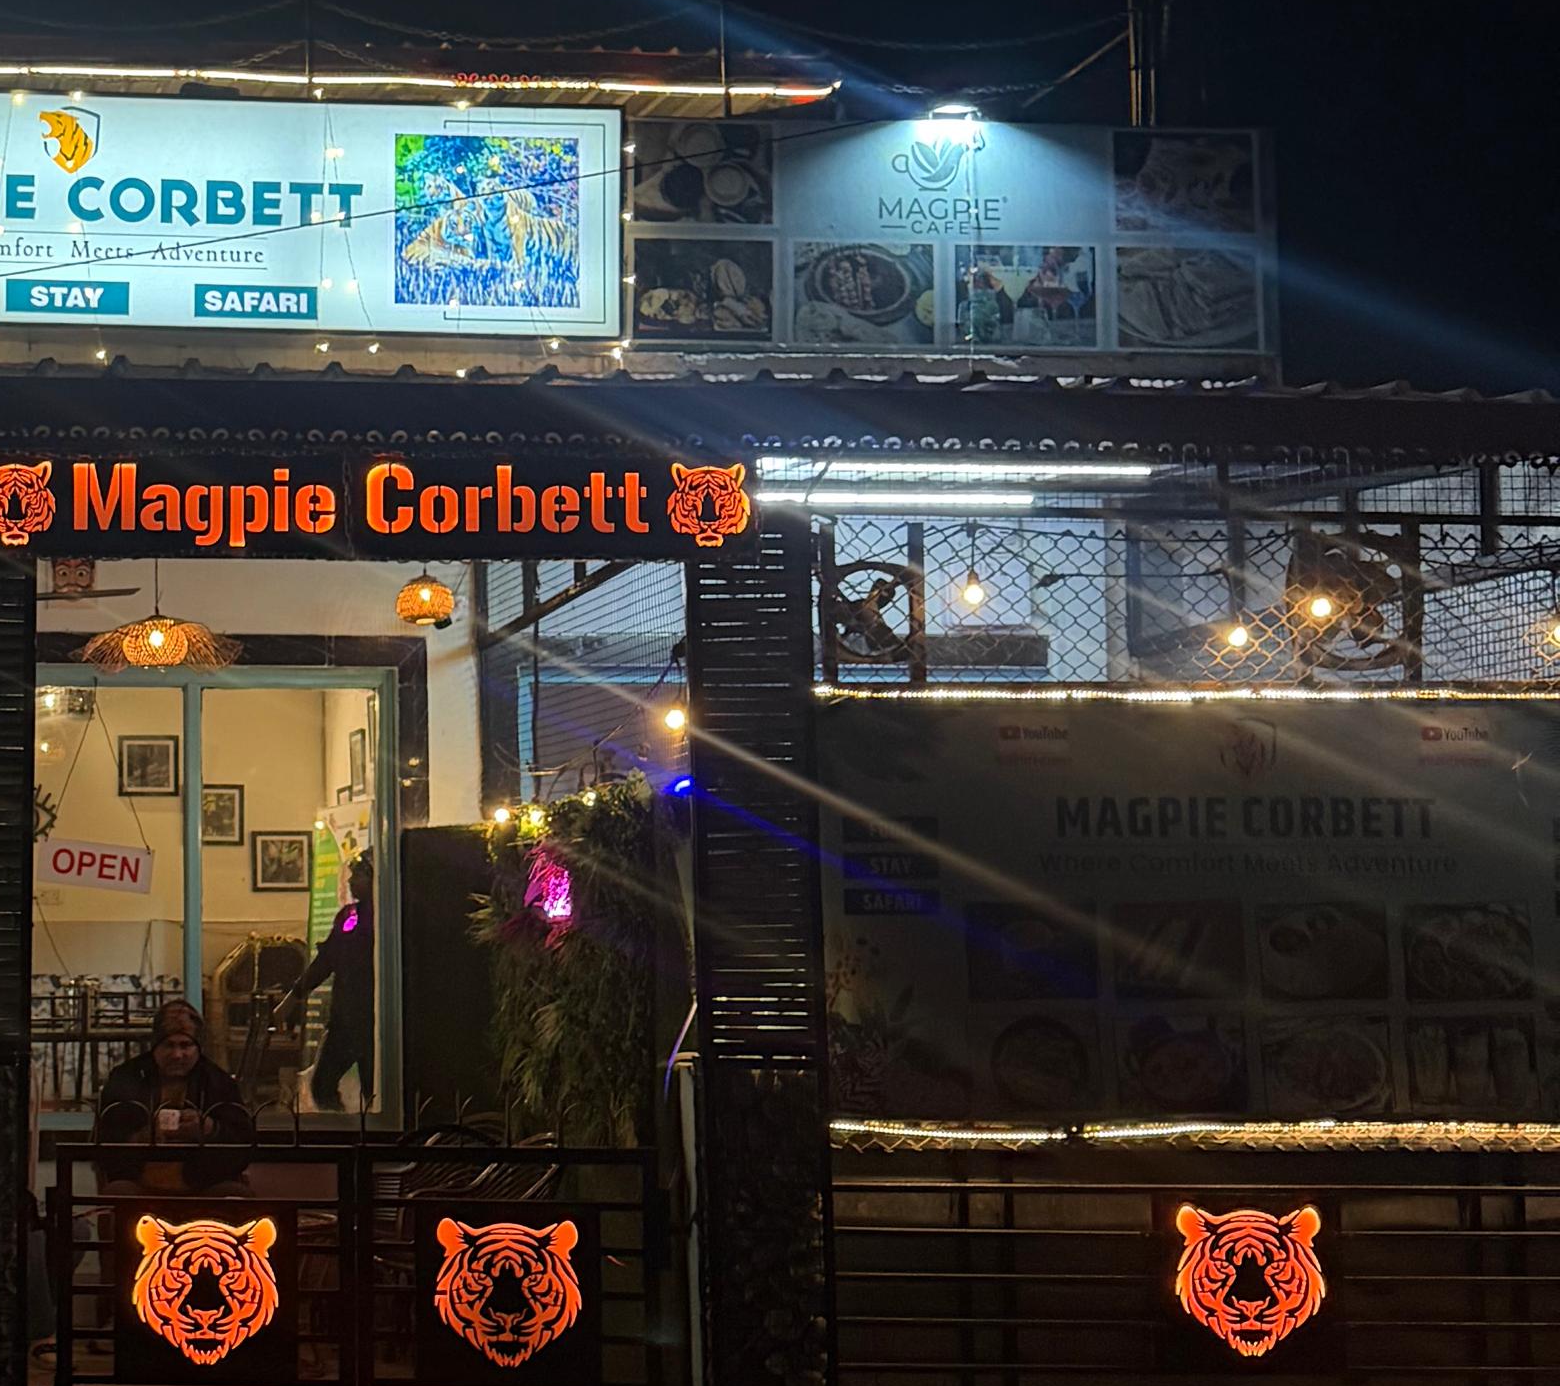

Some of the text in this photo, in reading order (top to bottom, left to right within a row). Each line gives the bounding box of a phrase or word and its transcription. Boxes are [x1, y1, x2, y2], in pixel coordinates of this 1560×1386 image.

[67, 176, 364, 228] CORBETT
[878, 196, 1001, 221] MAGPIE
[911, 220, 969, 234] CAFE
[71, 240, 134, 261] Meets
[151, 242, 264, 264] Adventure
[30, 286, 104, 309] STAY
[204, 290, 308, 314] SAFARI
[72, 462, 650, 548] Magpie Corbett
[1056, 796, 1437, 839] MAGPIE CORBETT
[52, 848, 140, 883] OPEN
